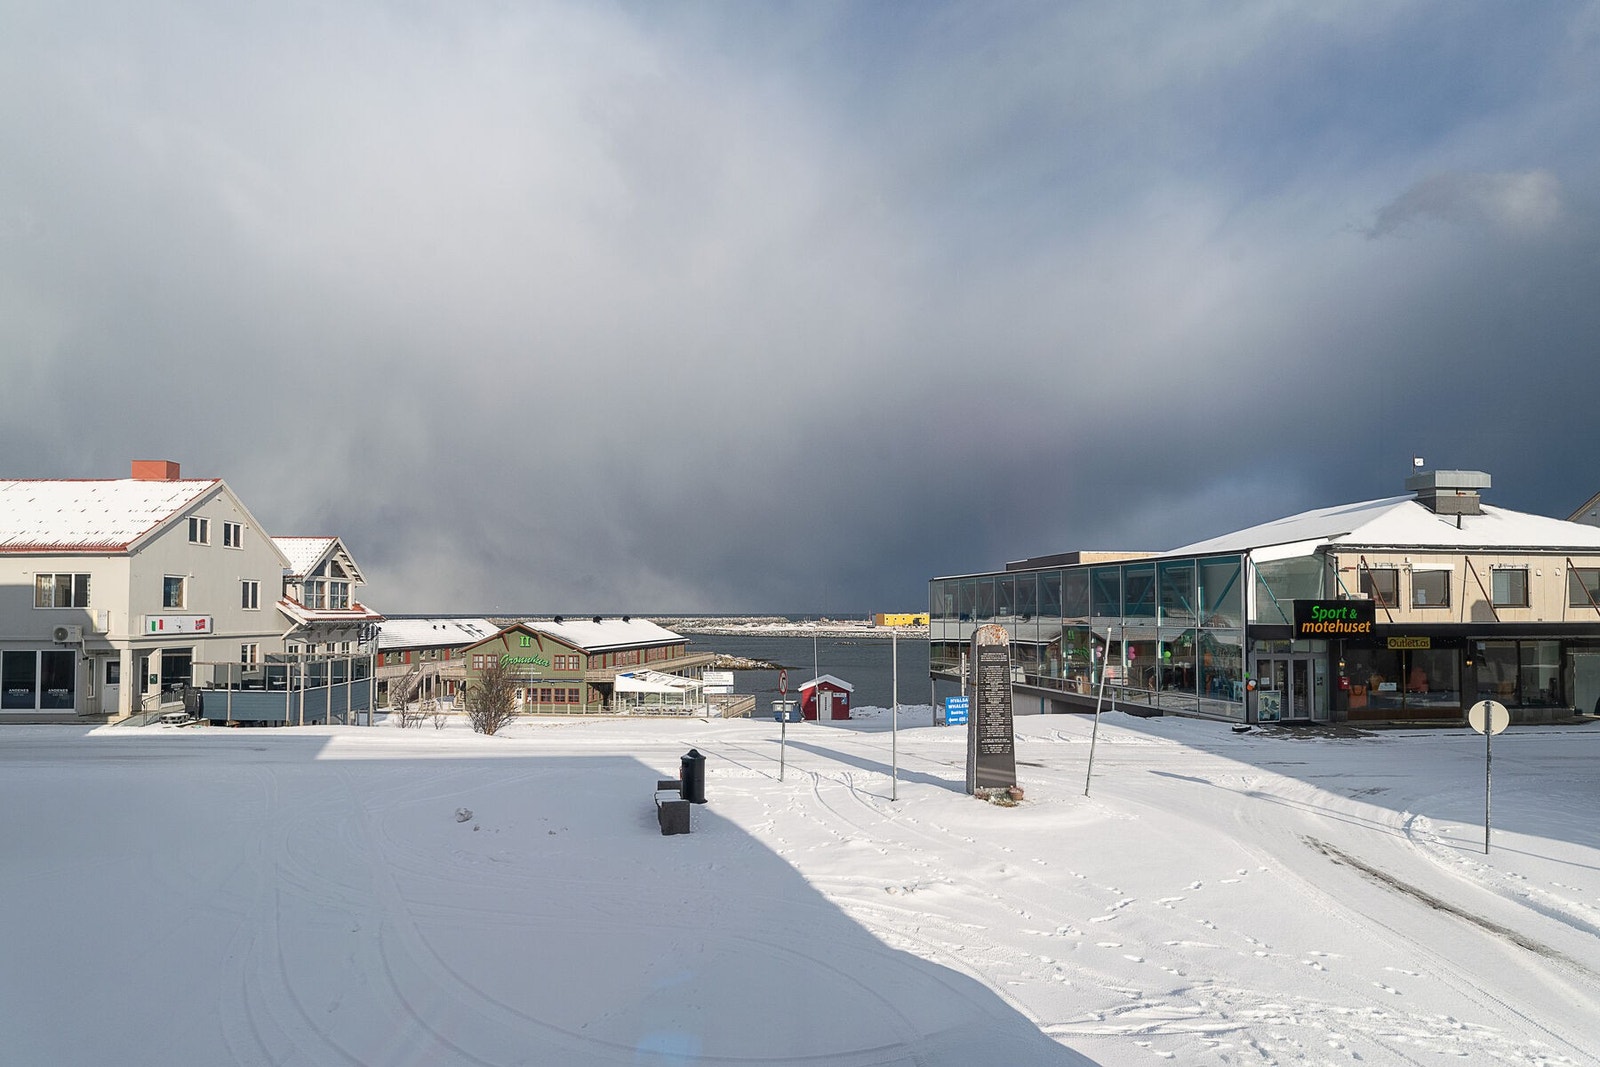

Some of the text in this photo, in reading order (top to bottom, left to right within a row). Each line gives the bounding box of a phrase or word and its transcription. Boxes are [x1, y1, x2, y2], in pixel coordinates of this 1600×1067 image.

[1311, 605, 1358, 621] Sport &
[1301, 619, 1371, 633] motehuset
